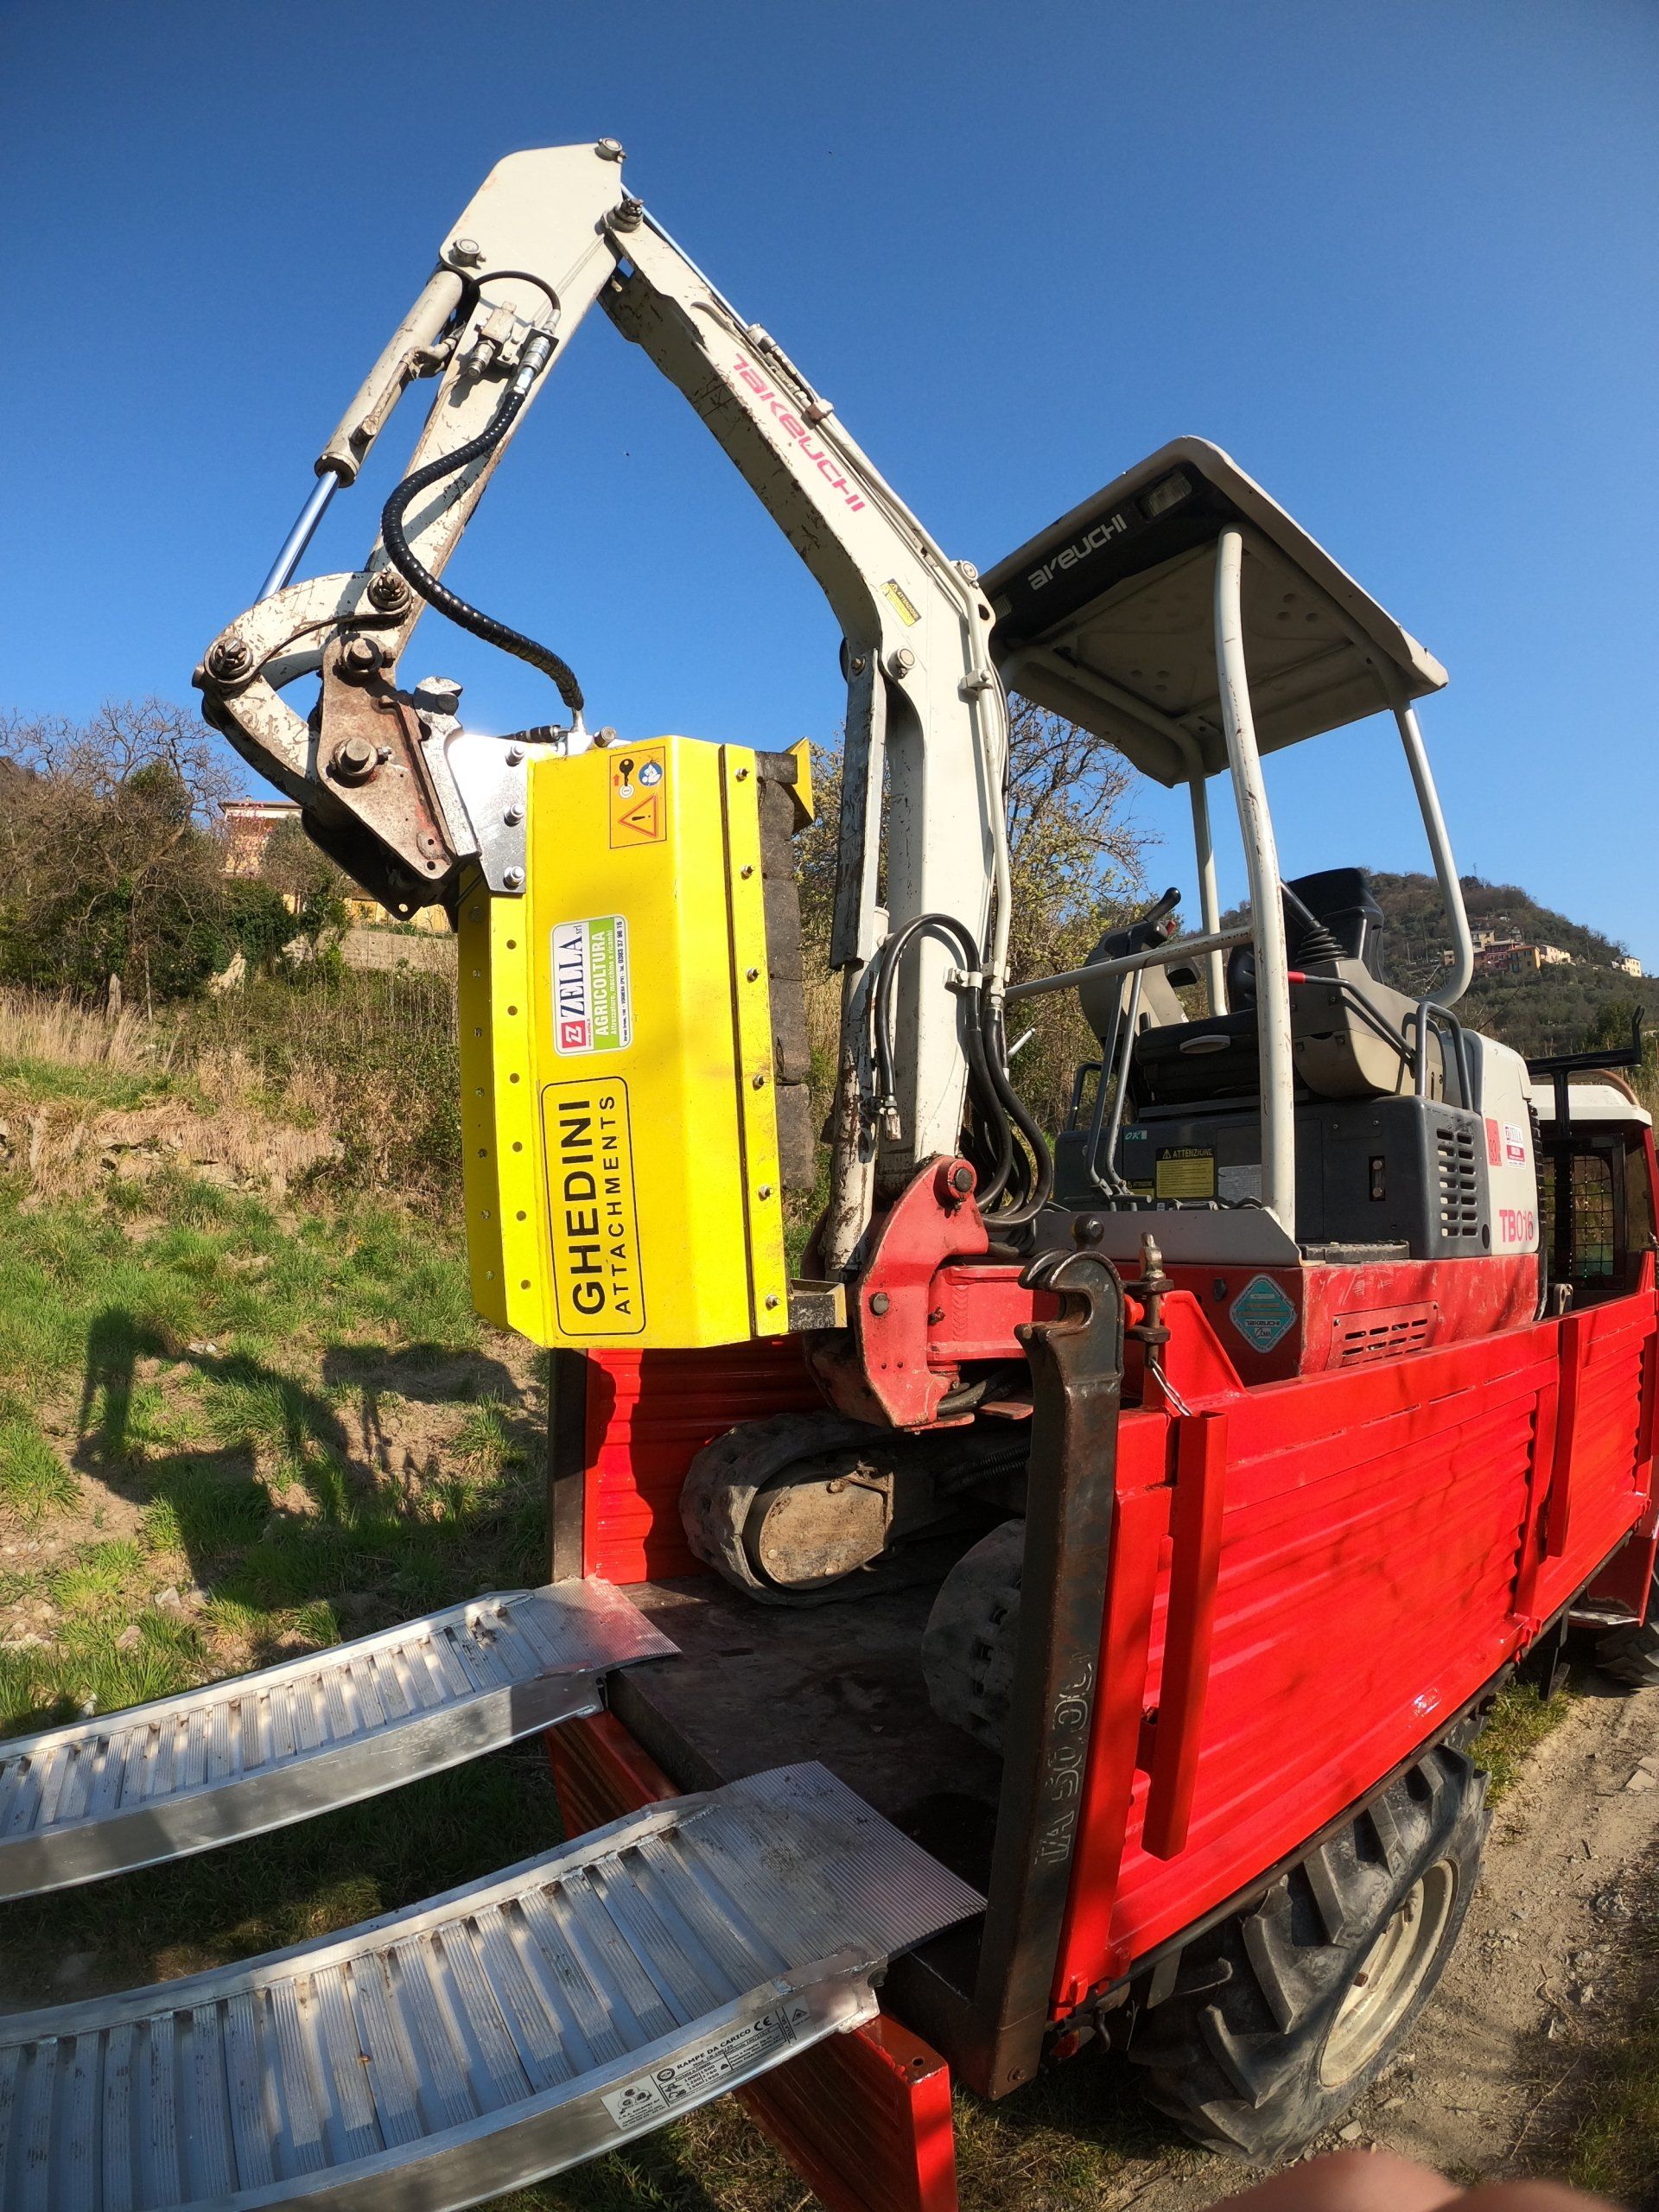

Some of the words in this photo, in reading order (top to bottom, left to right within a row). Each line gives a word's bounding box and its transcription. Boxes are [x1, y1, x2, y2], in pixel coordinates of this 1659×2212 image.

[733, 353, 866, 512] TAKEUCHI
[558, 936, 585, 1018] ZELLA
[573, 924, 583, 935] srl
[607, 963, 616, 991] macchine
[617, 938, 624, 950] 37
[591, 931, 609, 1036] AGRICOLTURA
[1173, 1147, 1213, 1159] ATTENZIONE
[558, 1100, 606, 1315] GHEDINI
[599, 1096, 631, 1315] ATTACHMENTS
[1499, 1209, 1535, 1243] TB016
[677, 2052, 706, 2070] RAMPE
[707, 2045, 719, 2056] DA
[720, 2029, 751, 2048] CARICO
